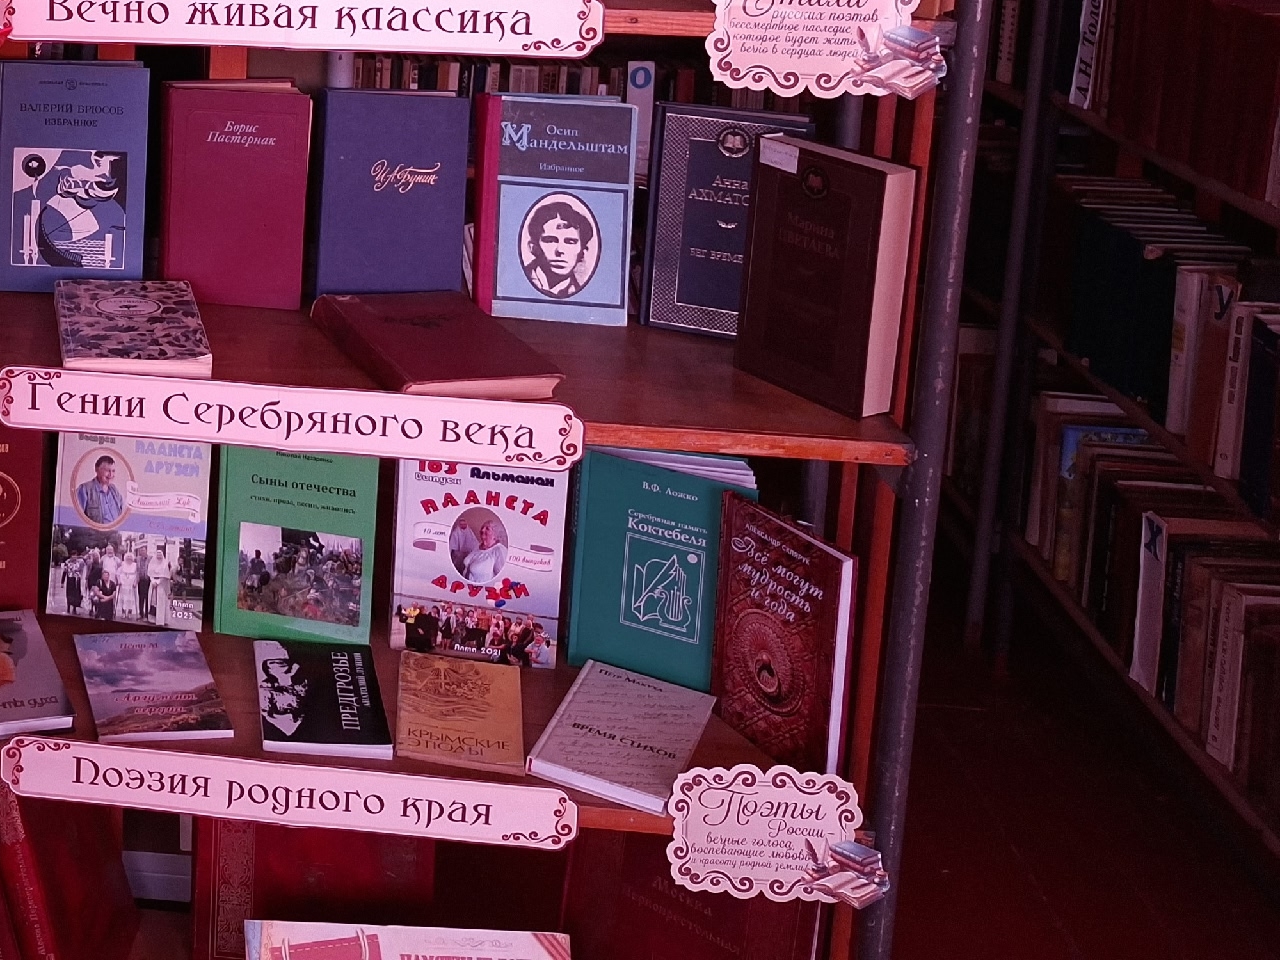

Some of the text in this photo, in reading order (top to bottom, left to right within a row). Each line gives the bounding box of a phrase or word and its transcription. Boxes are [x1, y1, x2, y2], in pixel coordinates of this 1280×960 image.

[184, 0, 318, 31] живая
[334, 3, 533, 41] классика
[772, 10, 878, 22] русских поэтов
[730, 19, 799, 34] бессмертное
[732, 33, 781, 44] которое
[785, 33, 819, 47] будет
[740, 43, 823, 58] вечно сердцах
[19, 101, 124, 115] ВАЛЕРИЙ БРЮСОВ
[44, 117, 98, 127] ИЗБРАННОЕ
[224, 120, 259, 134] Борис
[546, 124, 578, 137] Осип
[206, 131, 276, 147] Пастернак
[501, 121, 628, 155] Мандельштам
[539, 162, 585, 173] Избранное
[711, 175, 750, 190] Анна
[27, 381, 536, 453] Гении Серебряного века
[252, 474, 357, 497] Сыны отечества
[665, 487, 698, 502] Ложко
[420, 490, 550, 526] ПЛАНЕТА
[627, 516, 707, 547] Коктебеля
[738, 562, 811, 613] мудрость
[772, 564, 823, 600] могут
[764, 592, 796, 623] года
[331, 652, 361, 731] ПРЕДГРОЗЬЕ
[24, 695, 60, 710] духа
[406, 726, 510, 750] КРЫМСКИЕ
[408, 738, 485, 757] ЭТЮДЫ
[572, 721, 677, 759] ВРЕМЯ СТИХОВ
[72, 755, 493, 829] Поэзия родного края
[698, 787, 826, 826] Поэты
[691, 843, 765, 858] воспевающие
